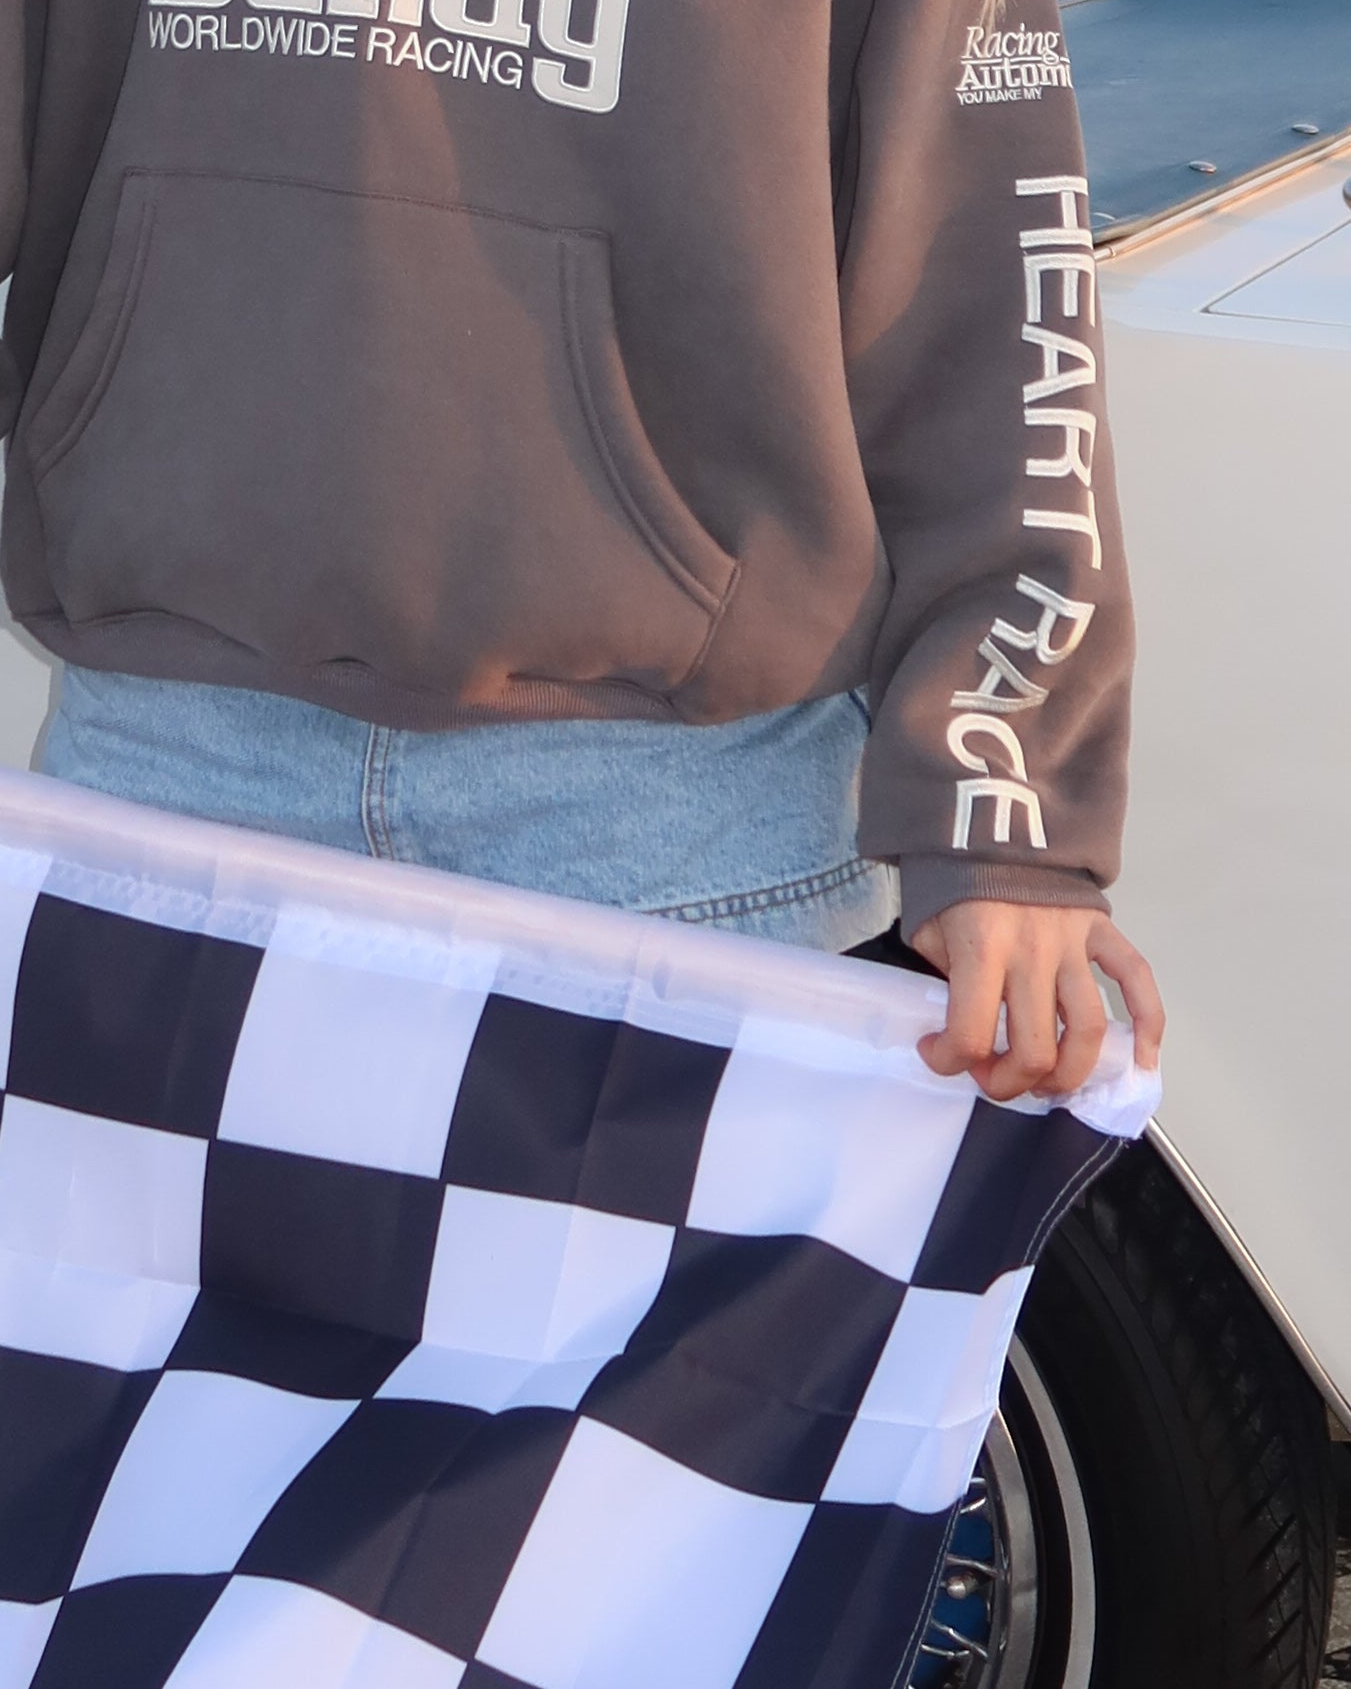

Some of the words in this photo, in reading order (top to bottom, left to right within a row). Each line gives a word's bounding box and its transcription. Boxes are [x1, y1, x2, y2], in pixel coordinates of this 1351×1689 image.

[149, 11, 359, 59] WORLDWIDE
[365, 26, 524, 90] RACING
[954, 57, 1073, 91] Autom
[961, 22, 1060, 65] Racing
[956, 91, 984, 106] YOU
[985, 88, 1023, 103] MAKE
[1023, 87, 1043, 100] MY
[1014, 175, 1102, 570] HEART
[946, 573, 1096, 850] RACE
